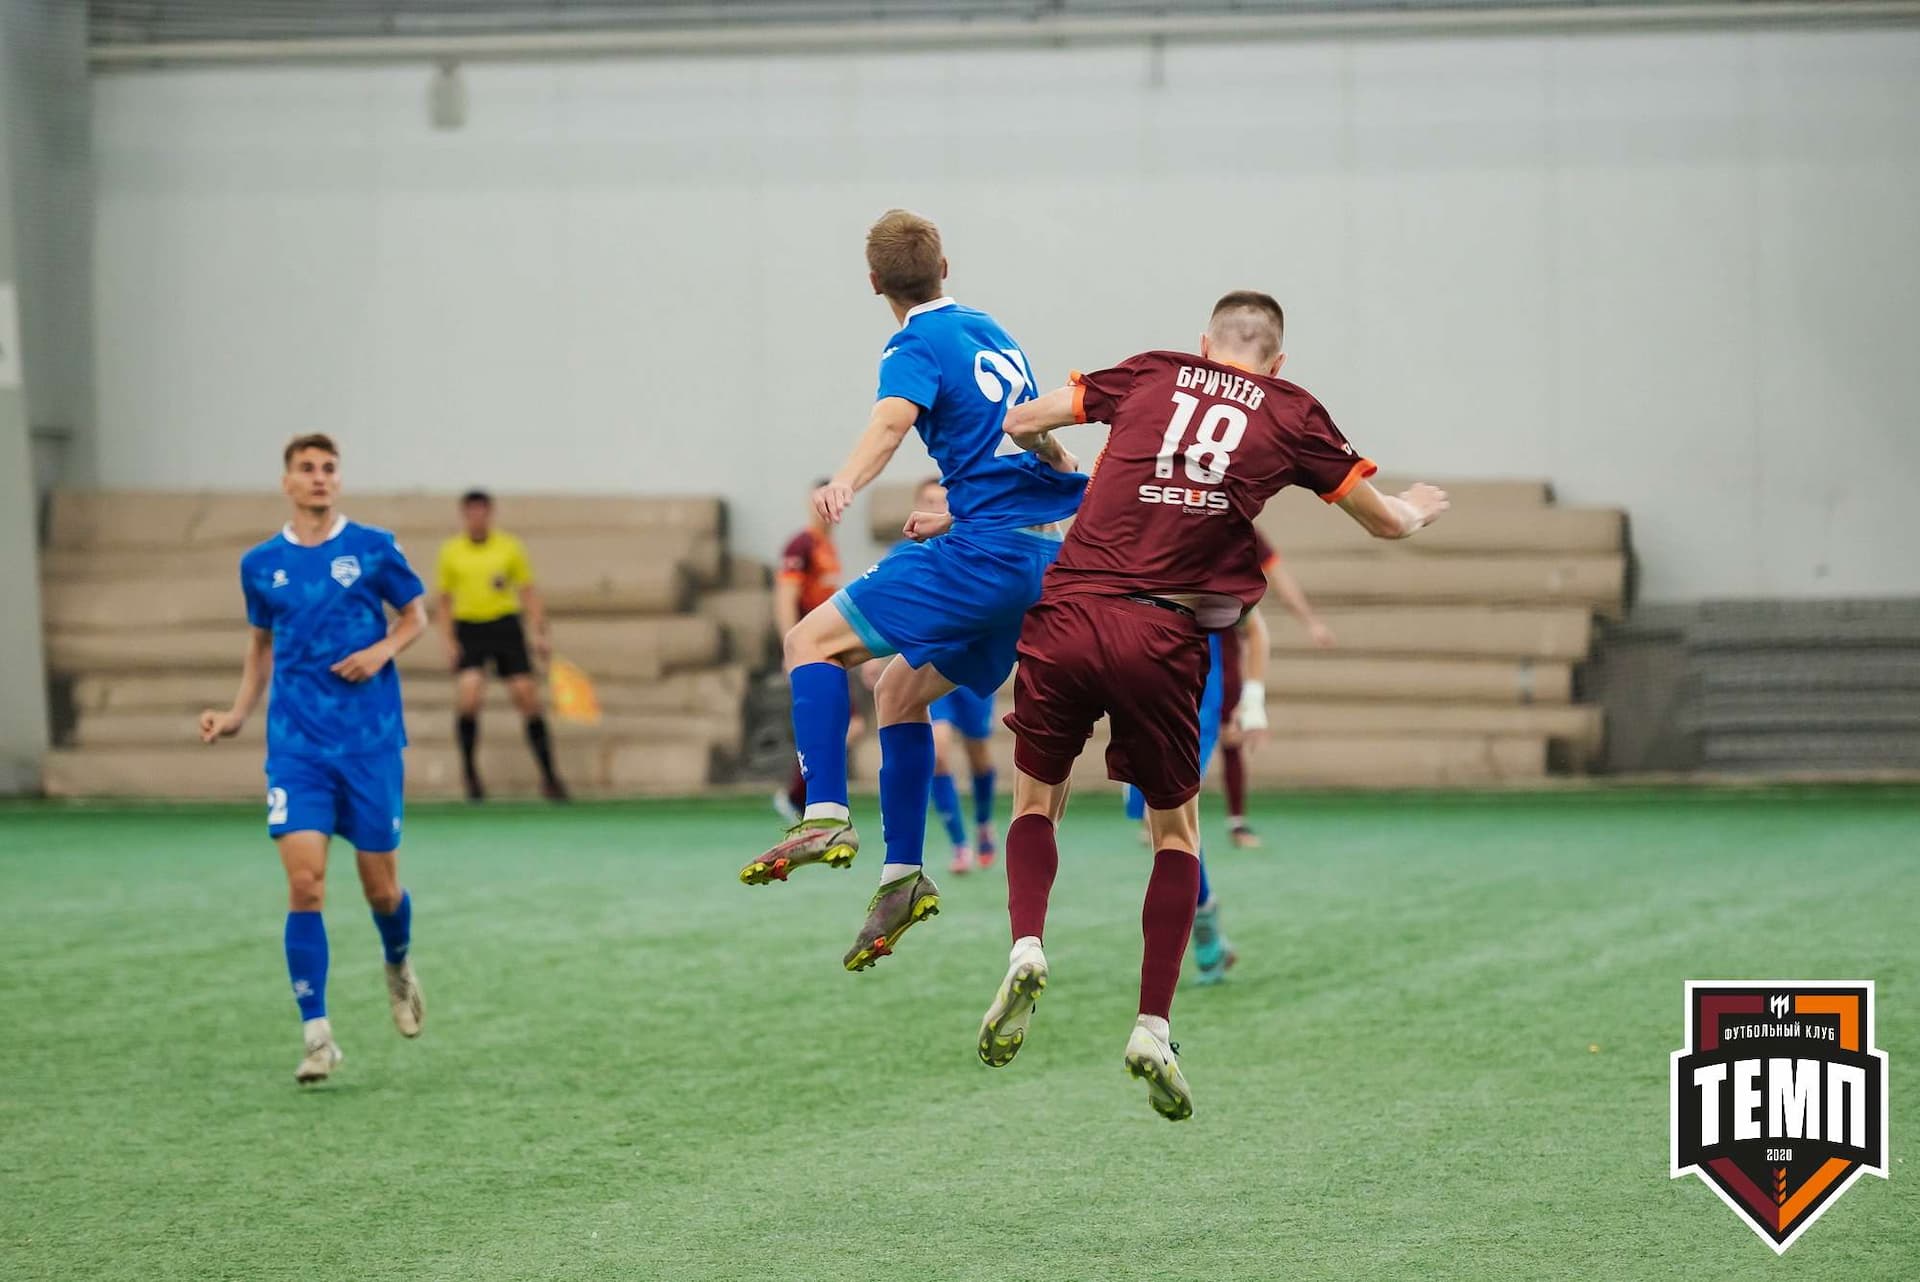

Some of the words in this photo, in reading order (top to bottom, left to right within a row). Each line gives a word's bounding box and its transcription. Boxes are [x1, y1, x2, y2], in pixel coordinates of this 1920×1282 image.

[1175, 366, 1266, 411] БРИЧЕЕВ
[1154, 391, 1249, 484] 18
[1138, 484, 1230, 510] SEUS
